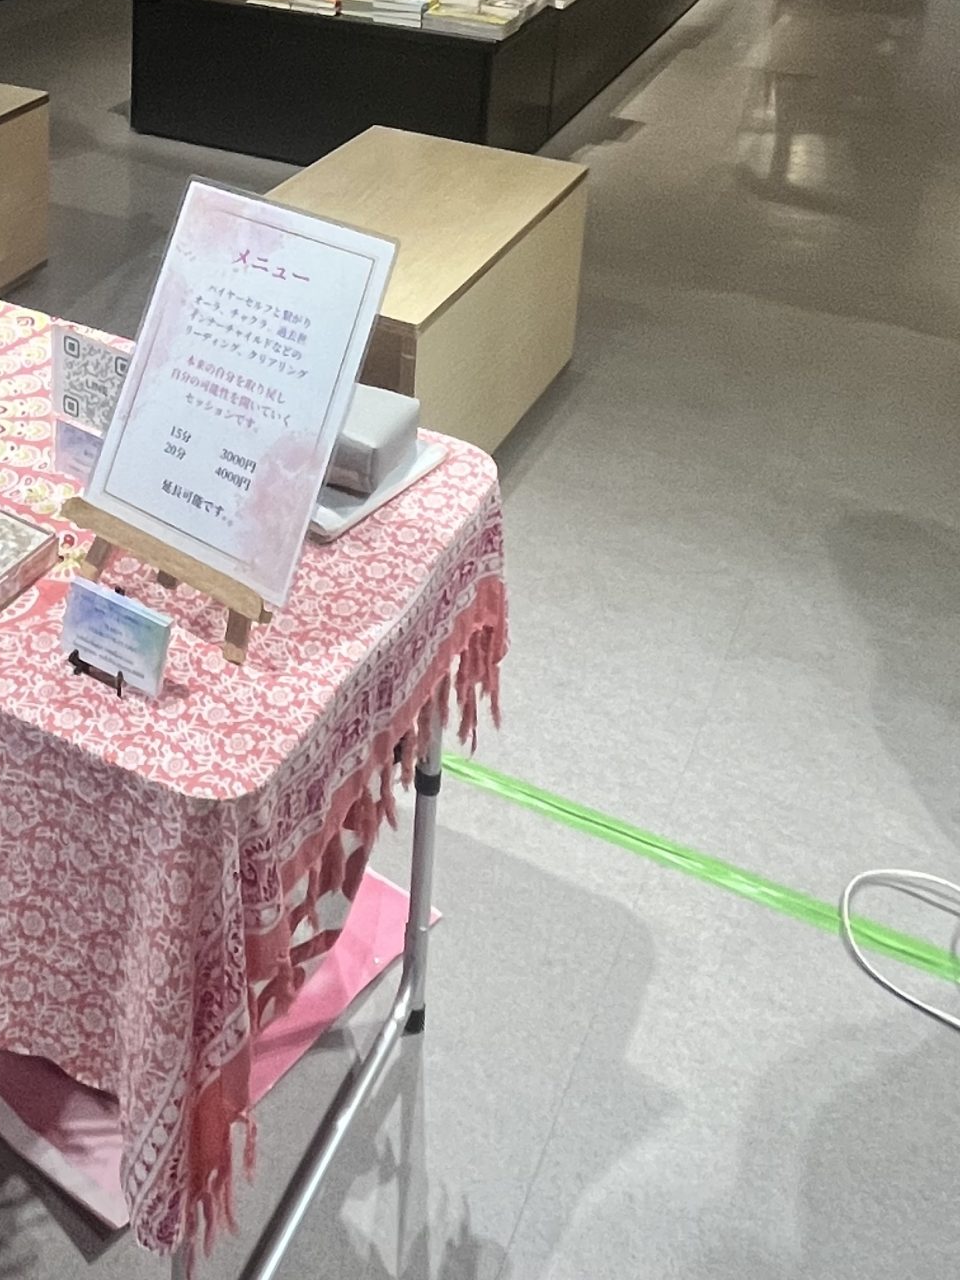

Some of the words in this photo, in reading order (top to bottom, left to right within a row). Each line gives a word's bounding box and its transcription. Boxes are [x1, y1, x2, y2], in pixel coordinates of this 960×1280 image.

[232, 249, 311, 283] メニュー
[163, 441, 187, 460] 20分
[214, 466, 252, 492] 4000円
[170, 425, 192, 443] 15分
[220, 448, 257, 473] 3000円
